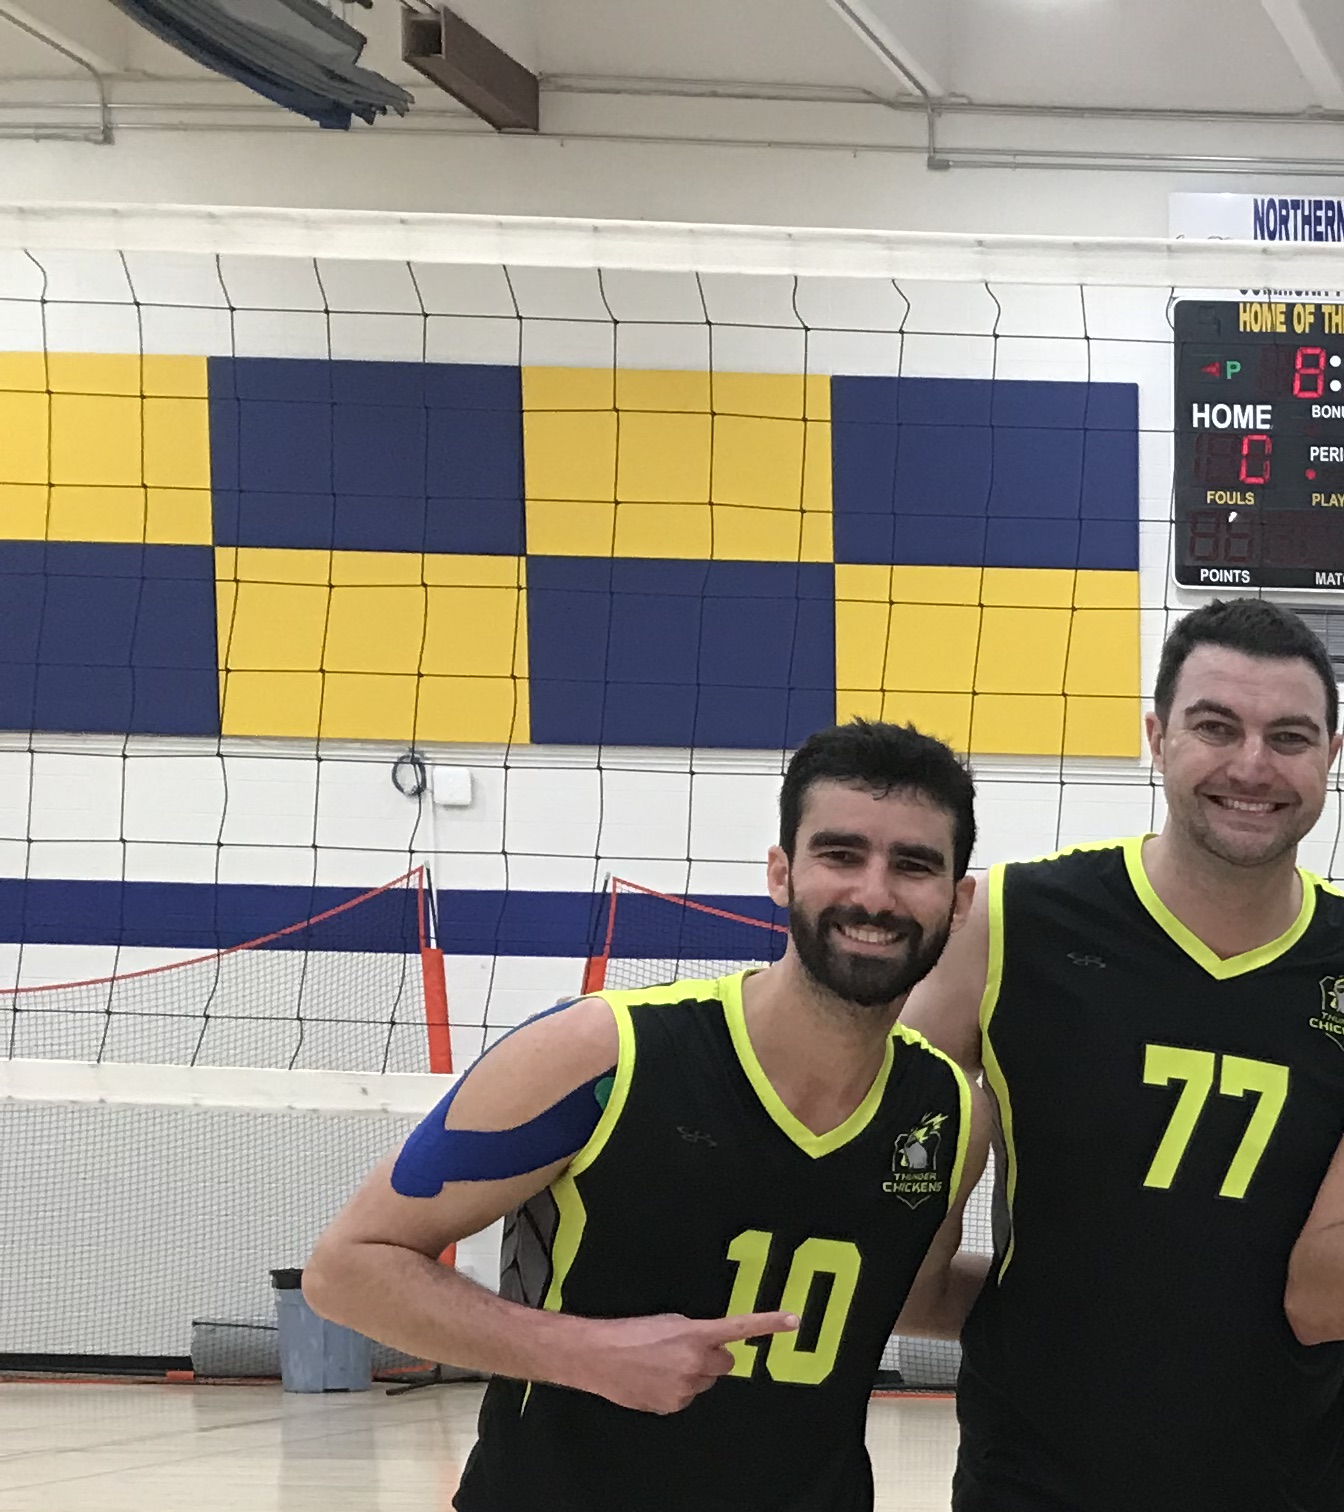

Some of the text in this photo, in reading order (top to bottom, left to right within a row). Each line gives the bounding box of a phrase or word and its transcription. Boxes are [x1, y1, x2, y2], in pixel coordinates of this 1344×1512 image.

[1239, 303, 1287, 333] HOME
[1293, 304, 1315, 334] OF
[1226, 360, 1241, 380] P
[1192, 404, 1273, 430] HOME
[1239, 434, 1273, 485] 0
[1206, 491, 1255, 506] FOULS
[1200, 568, 1251, 584] POINTS
[1143, 1044, 1290, 1199] 77
[882, 1181, 943, 1193] CHICKENS
[726, 1229, 862, 1385] 10
